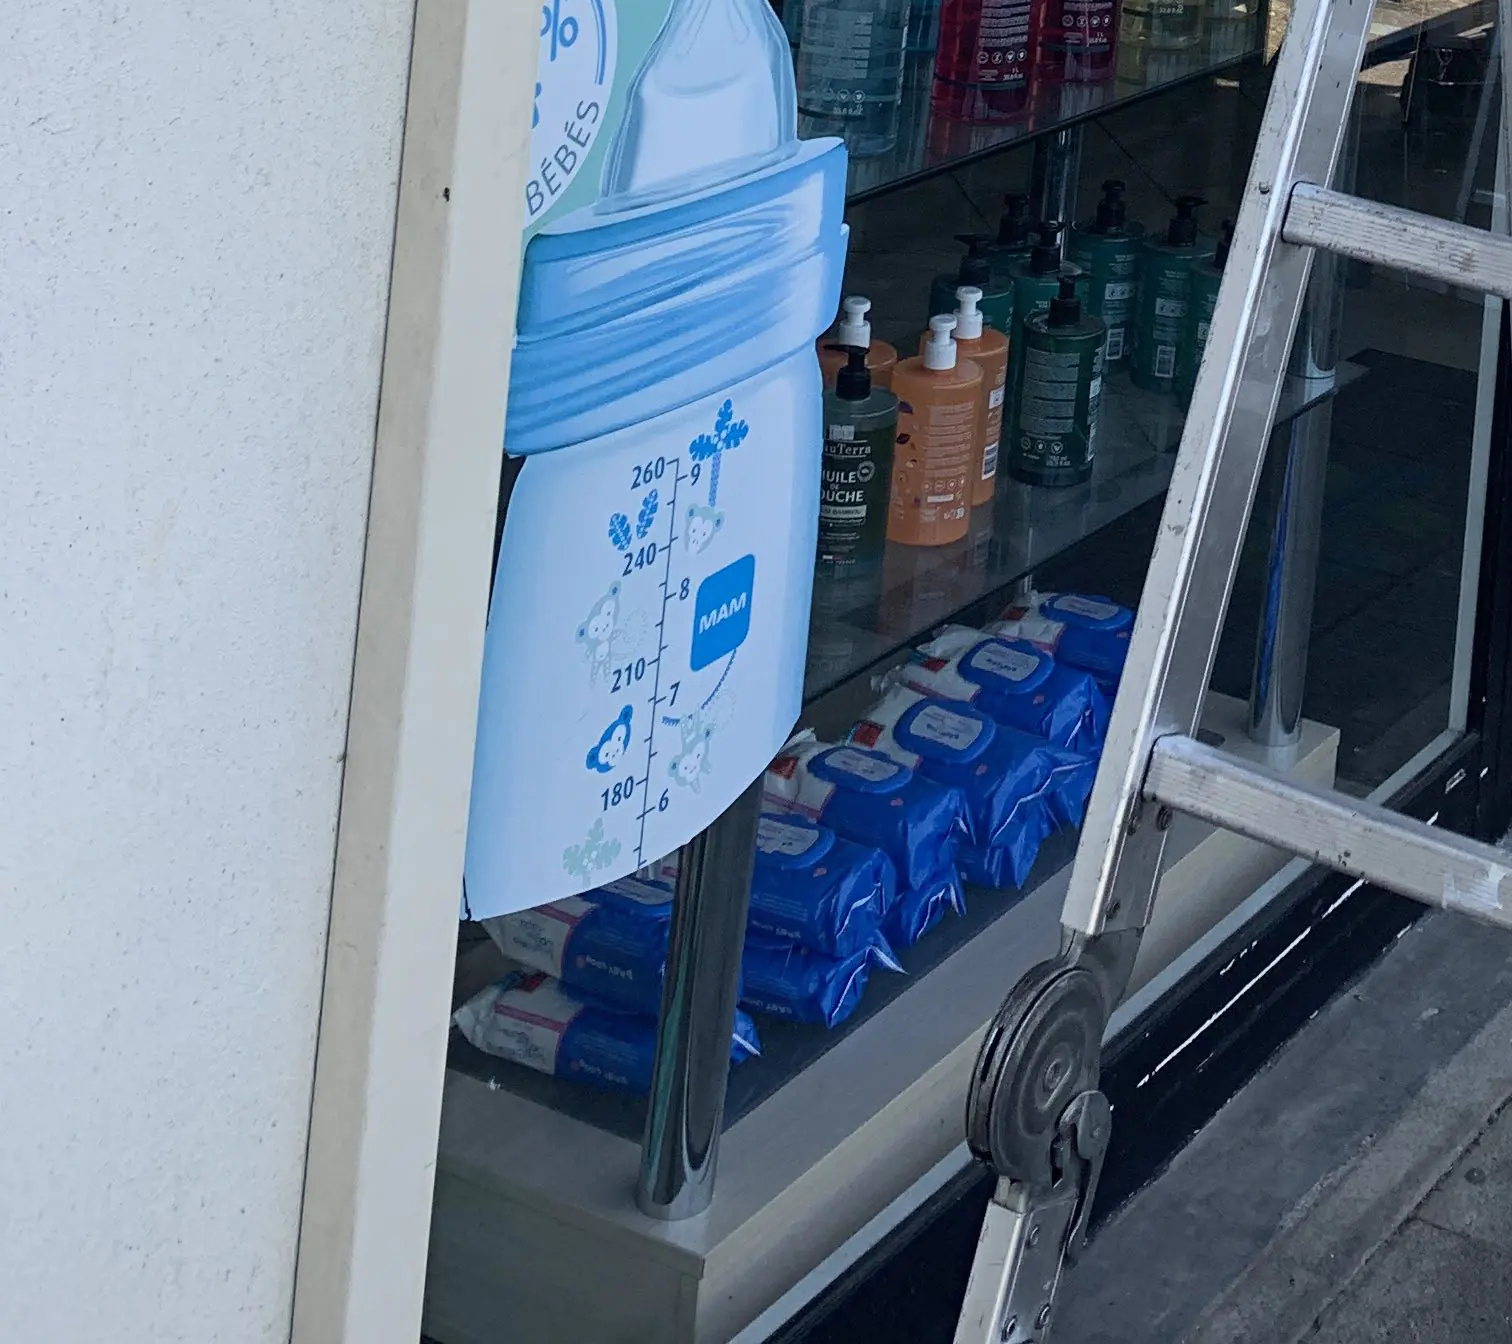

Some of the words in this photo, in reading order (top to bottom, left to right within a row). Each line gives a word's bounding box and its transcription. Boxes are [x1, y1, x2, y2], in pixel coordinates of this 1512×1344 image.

[632, 456, 665, 489] 260
[690, 464, 702, 487] 9
[623, 546, 657, 577] 240
[678, 578, 690, 601] 8
[698, 591, 748, 636] MAM
[611, 658, 646, 692] 210
[668, 683, 679, 705] 7
[601, 778, 634, 811] 180
[658, 789, 669, 811] 6
